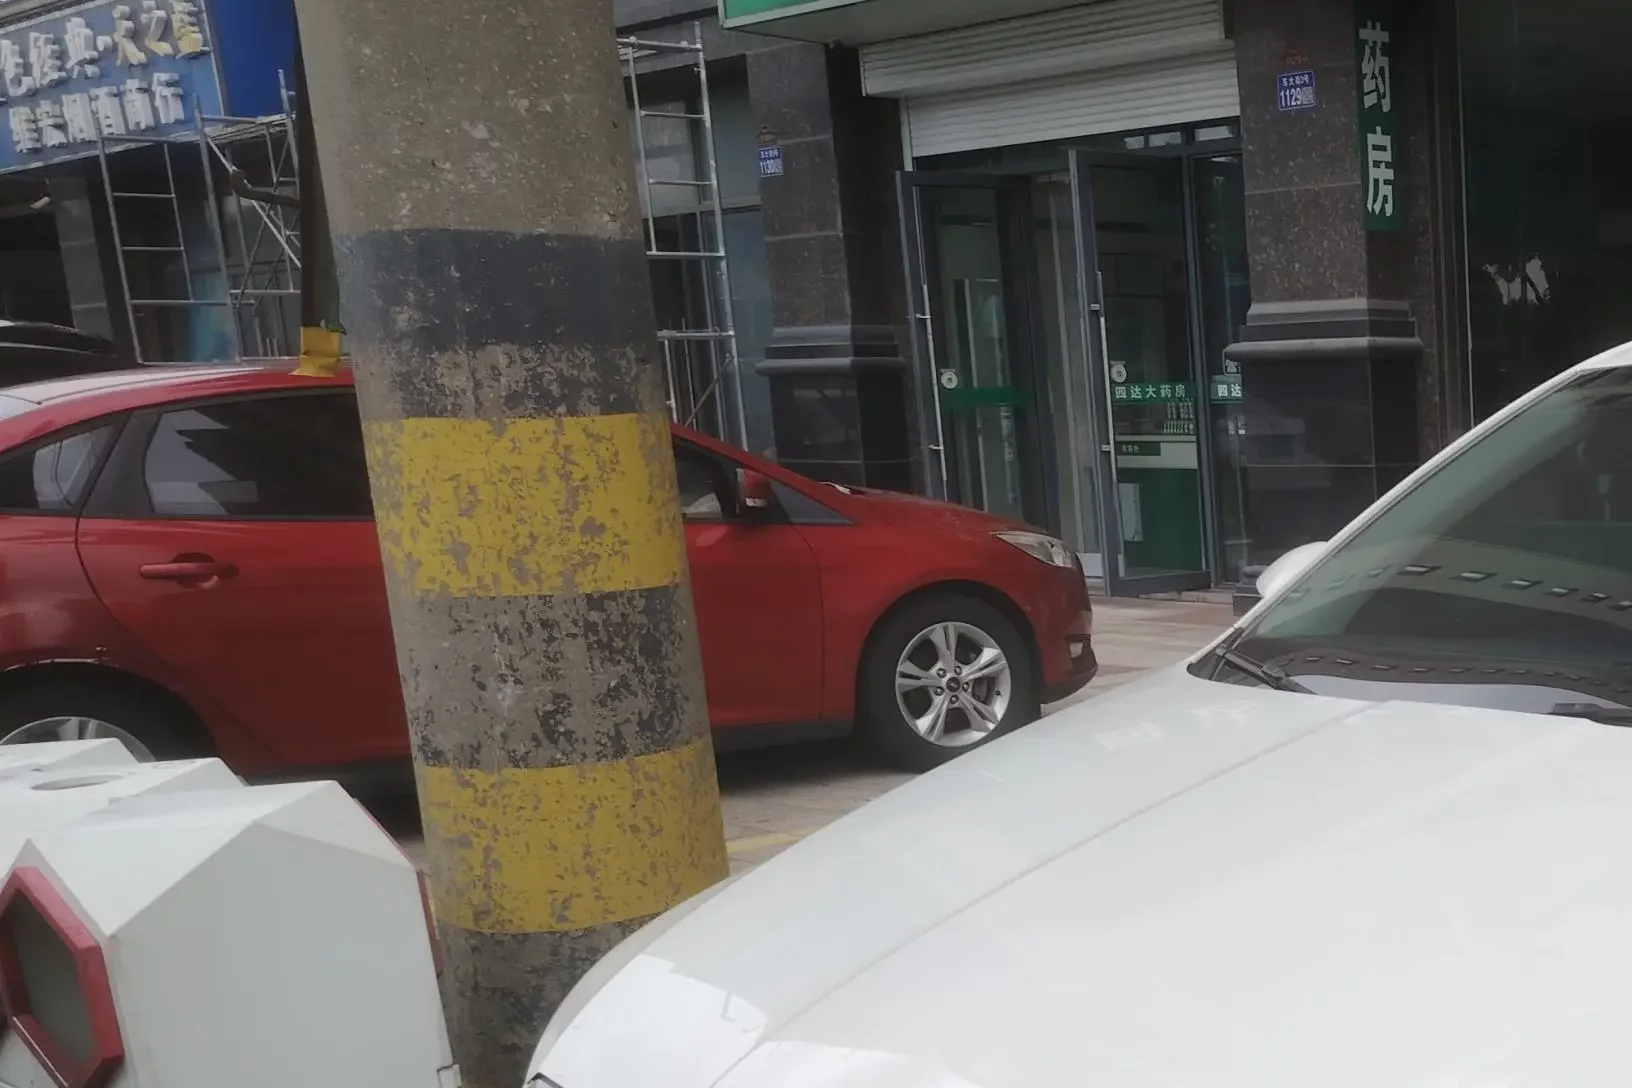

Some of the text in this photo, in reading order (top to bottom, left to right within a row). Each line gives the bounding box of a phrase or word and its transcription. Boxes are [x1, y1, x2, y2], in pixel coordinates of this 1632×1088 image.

[1279, 87, 1302, 107] 1129
[1358, 19, 1395, 217] 药房
[1115, 384, 1186, 399] 四达大药房
